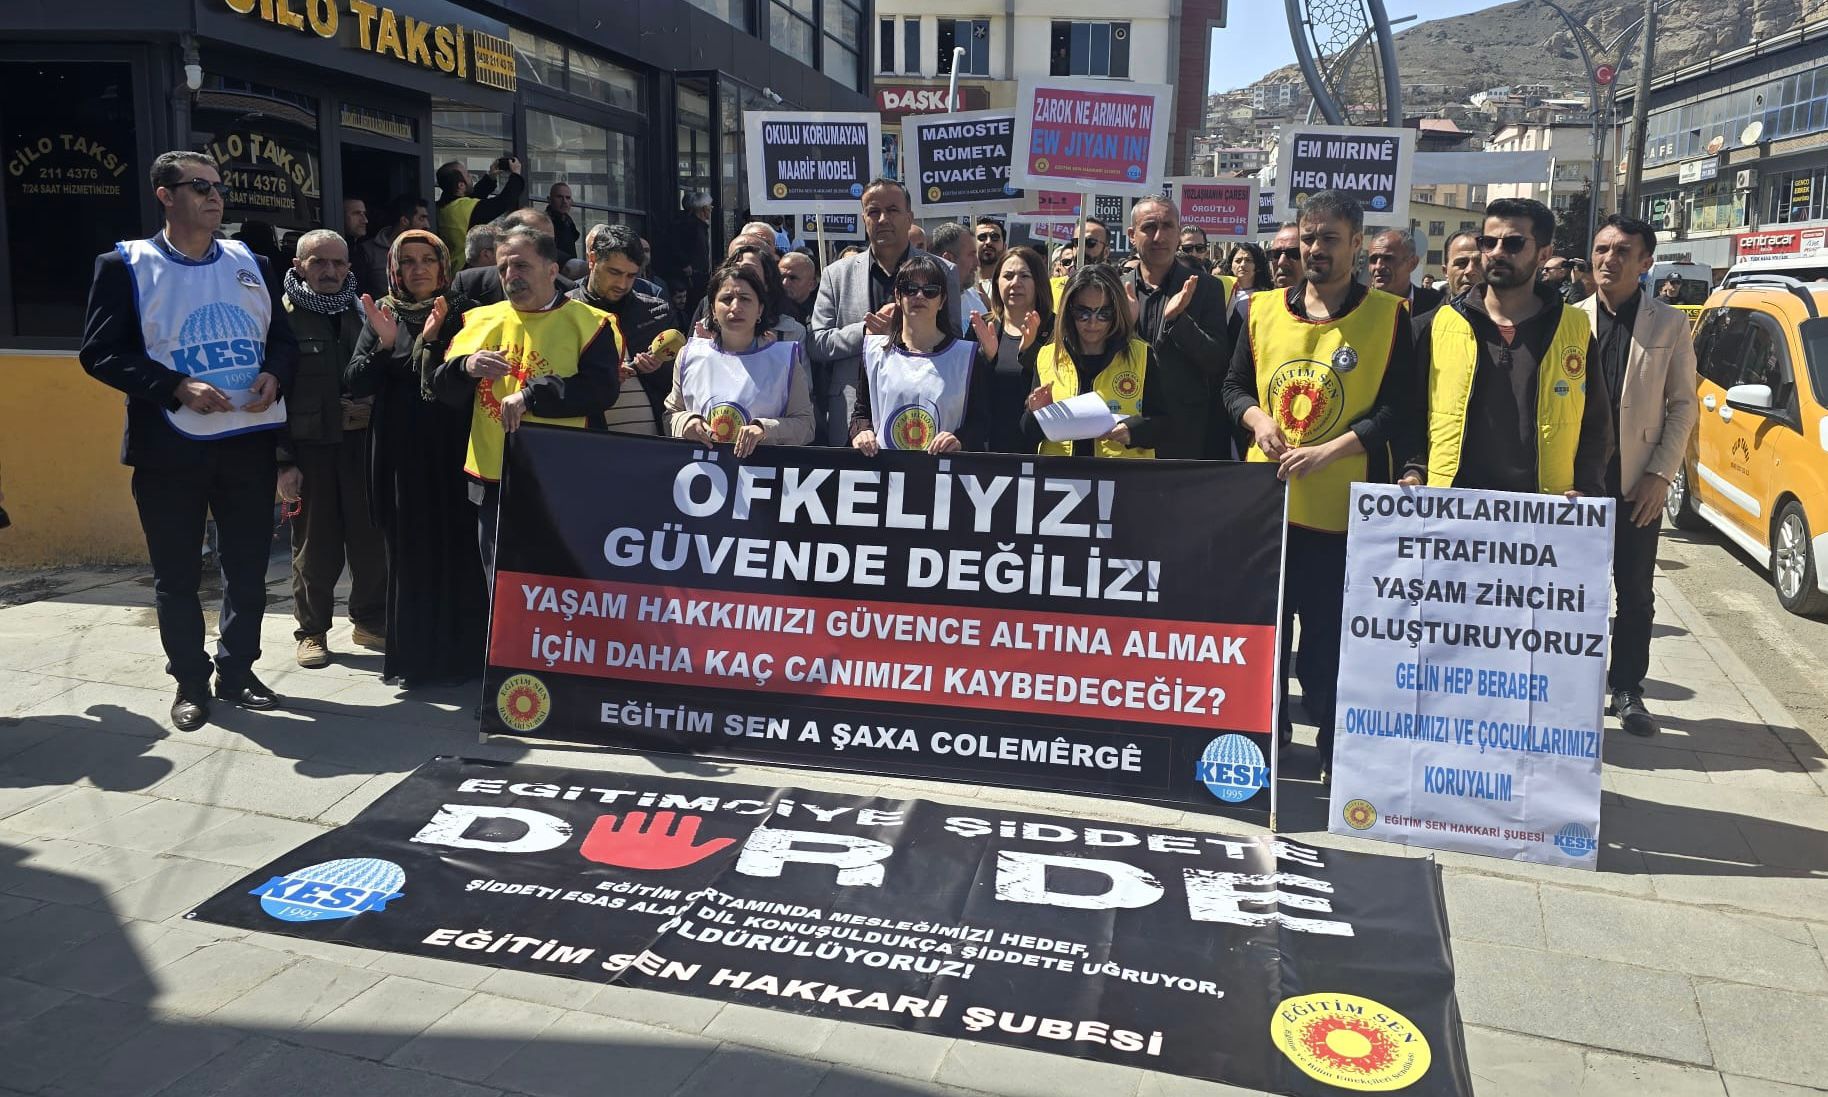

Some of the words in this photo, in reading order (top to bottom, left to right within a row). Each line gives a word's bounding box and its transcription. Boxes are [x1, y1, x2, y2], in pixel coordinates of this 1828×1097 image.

[350, 0, 466, 79] TAKSİ
[1034, 98, 1073, 122] ZAROK
[1074, 102, 1090, 122] NE
[1092, 103, 1138, 128] ARMANC
[1138, 104, 1151, 129] IN
[765, 124, 800, 145] OKULU
[803, 125, 866, 145] KORUMAYAN
[922, 121, 1010, 141] MAMOSTE
[1032, 128, 1062, 154] EW
[1065, 130, 1118, 159] JIYAN
[1122, 136, 1148, 161] IN!
[9, 136, 52, 177] CİLO
[60, 133, 129, 178] TAKSİ
[933, 143, 1006, 162] RÛMETA
[1297, 140, 1322, 158] EM
[1326, 139, 1393, 160] MIRINÊ
[1644, 143, 1673, 159] AFE
[39, 168, 62, 179] 211
[66, 168, 98, 180] 4376
[223, 170, 248, 187] 211
[254, 173, 286, 193] 4376
[778, 156, 815, 180] MAARİF
[818, 157, 857, 180] MODELİ
[922, 165, 986, 184] CIVAKÊ
[1292, 170, 1328, 190] HEQ
[1332, 172, 1393, 191] NAKIN
[40, 183, 61, 195] SAAT
[62, 183, 121, 196] HİZMETİNİZDE
[805, 213, 855, 224] POTİKTİR!
[1191, 204, 1236, 213] ÖRGÜTLÜ
[1740, 234, 1797, 248] centracar
[1272, 366, 1315, 396] EĞİTİM
[1318, 374, 1339, 399] SEN
[672, 449, 1116, 539] ÖFKELİYİZ!
[1357, 493, 1607, 528] ÇOCUKLARIMIZIN
[603, 522, 888, 586] GÜVENDE
[906, 541, 1161, 603] DEĞİLİZ!
[1398, 536, 1558, 568] ETRAFINDA
[1372, 576, 1467, 606] YAŞAM
[1475, 578, 1585, 613] ZİNCİRİ
[521, 584, 628, 621] YAŞAM
[637, 596, 815, 635] HAKKIMIZI
[826, 606, 981, 646] GÜVENCE
[990, 621, 1113, 656] ALTINA
[1122, 630, 1247, 665] ALMAK
[1350, 615, 1604, 658] OLUŞTURUYORUZ
[530, 627, 596, 667] İÇİN
[606, 641, 693, 673] DAHA
[704, 649, 774, 687] KAÇ
[784, 656, 933, 692] CANIMIZI
[943, 667, 1226, 716] KAYBEDECEĞİZ?
[1395, 658, 1439, 692] GELİN
[1443, 667, 1474, 695] HEP
[1477, 669, 1549, 702] BERABER
[600, 700, 714, 734] EĞİTİM
[723, 714, 790, 740] SEN
[798, 720, 821, 743] A
[830, 723, 920, 752] ŞAXA
[930, 730, 1142, 772] COLEMÊRGÊ
[1345, 707, 1450, 743] OKULLARIMIZI
[1454, 719, 1474, 746] VE
[1477, 720, 1600, 759] ÇOCUKLARIMIZI
[1197, 760, 1270, 788] KESK
[1424, 765, 1512, 802] KORUYALIM
[1221, 788, 1243, 801] 1995
[943, 815, 1325, 868] ŞİDDETE
[1384, 814, 1422, 829] EĞİTİM
[1424, 819, 1449, 832] SEN
[1450, 823, 1501, 838] HAKKARİ
[1504, 829, 1545, 843] ŞUBESİ
[1555, 834, 1597, 850] KESK
[252, 876, 404, 912] KESK
[278, 906, 321, 919] 1995
[596, 880, 682, 900] EĞİTİM
[828, 912, 994, 943] MESLEĞİMİZİ
[1000, 932, 1090, 959] HEDEF,
[465, 878, 559, 901] ŞİDDETİ
[563, 890, 626, 909] ESAS
[697, 905, 736, 925] DİL
[743, 916, 953, 956] KONUŞULDUKÇA
[960, 945, 1074, 973] ŞİDDETE
[1082, 961, 1225, 999] UĞRUYOR,
[421, 927, 597, 965] EĞİTİM
[601, 948, 702, 981] SEN
[708, 968, 949, 1019] HAKKARİ
[961, 1006, 1165, 1057] ŞUBESİ
[1281, 999, 1364, 1023] EĞİTİM
[1373, 1012, 1418, 1044] SEN
